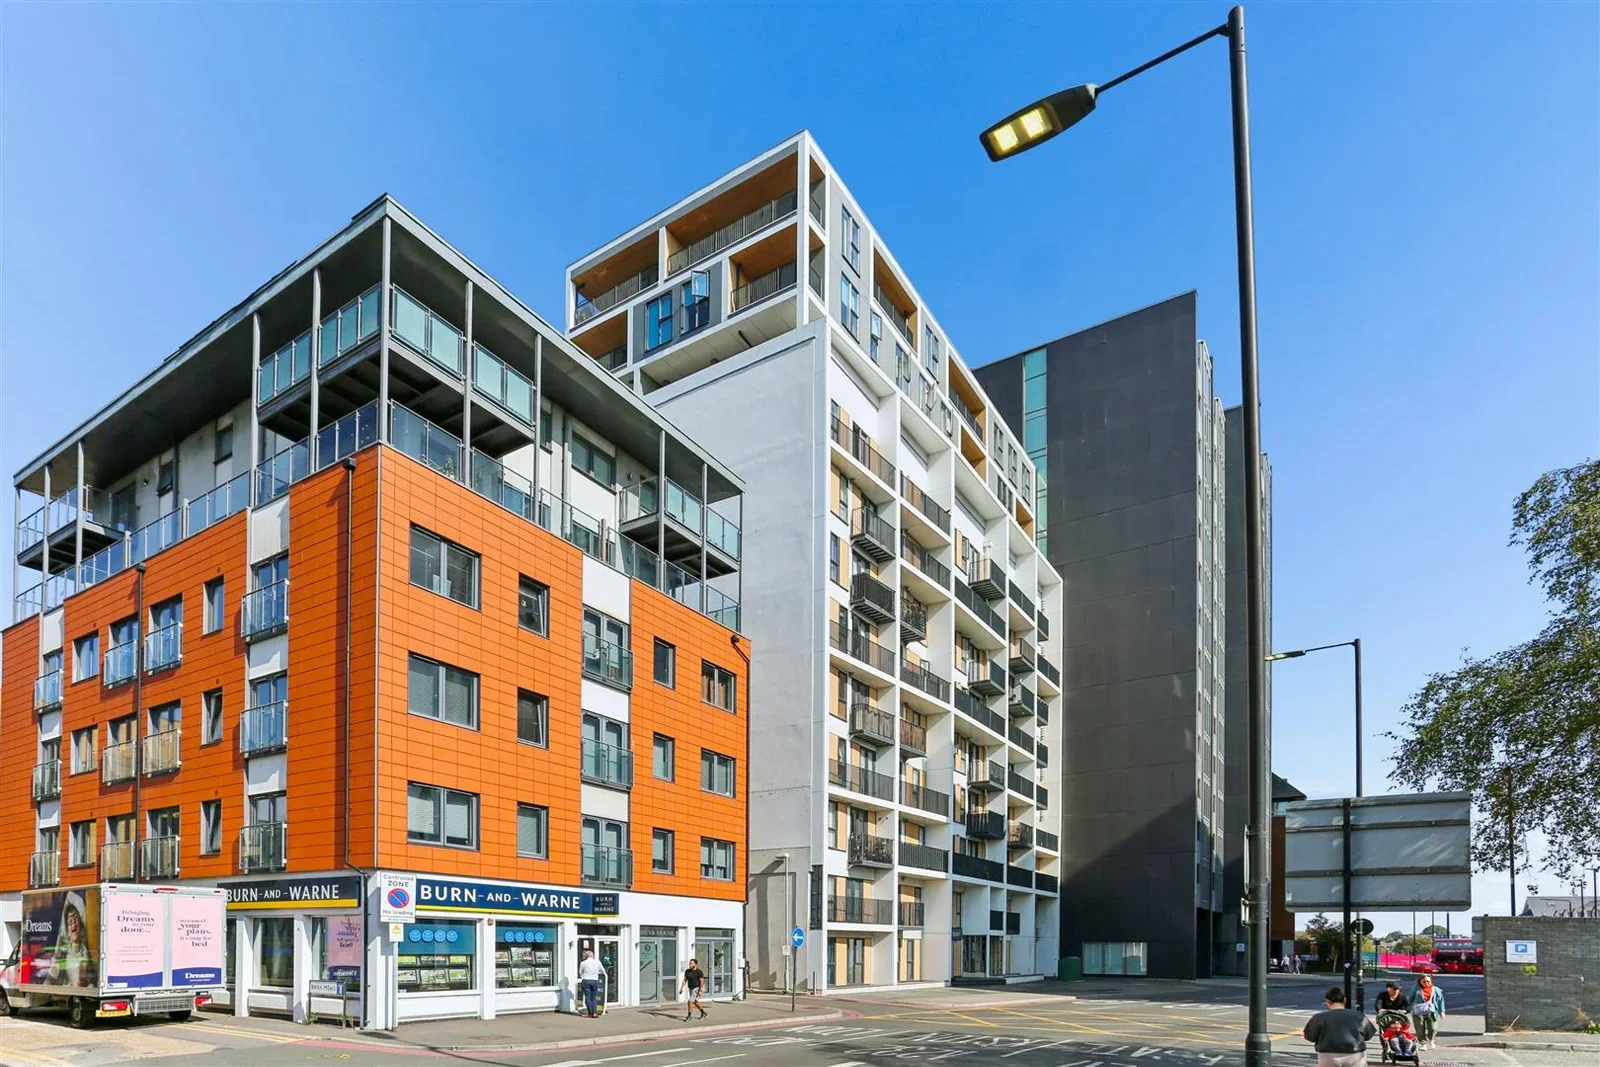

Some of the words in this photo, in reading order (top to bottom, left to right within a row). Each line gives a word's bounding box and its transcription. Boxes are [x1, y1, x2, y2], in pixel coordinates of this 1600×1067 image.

[383, 873, 414, 881] Controlled
[226, 887, 258, 902] BURN
[263, 889, 281, 899] AND
[289, 884, 340, 900] WARNE
[420, 884, 477, 903] BURN
[486, 893, 512, 903] AND
[521, 892, 581, 909] WARNE
[26, 919, 52, 932] Dreams
